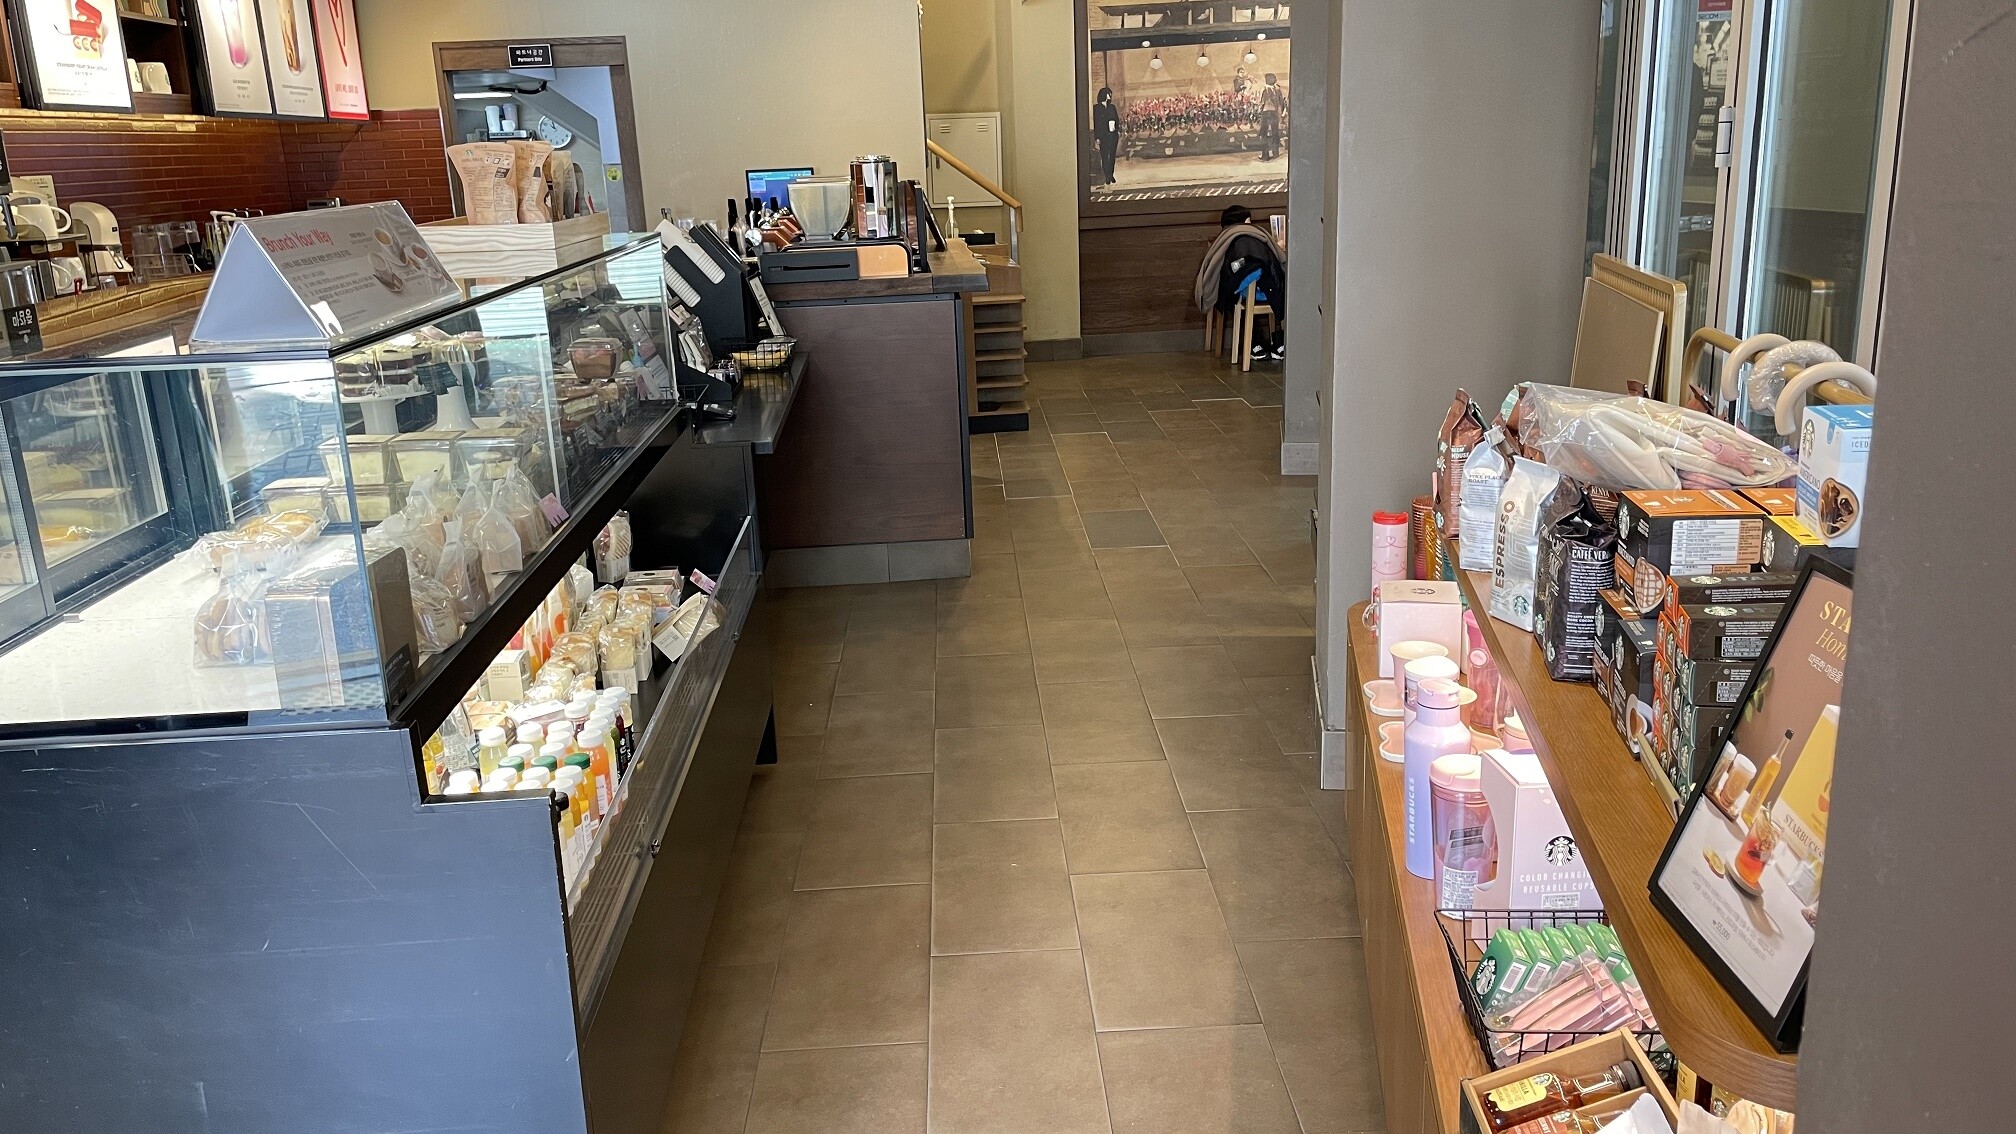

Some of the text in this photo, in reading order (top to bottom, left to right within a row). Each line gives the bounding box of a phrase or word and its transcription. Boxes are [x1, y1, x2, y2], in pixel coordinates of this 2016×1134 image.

[261, 233, 298, 253] Brunch
[291, 231, 316, 247] Your
[310, 228, 334, 245] Way
[1494, 500, 1516, 590] ESPRESSO
[1808, 653, 1844, 684] 따뜻한 마음을
[1784, 814, 1825, 858] STARBUCKS
[1519, 870, 1591, 883] COLOR CHANGI
[1523, 882, 1594, 894] REUSABLE CUPS
